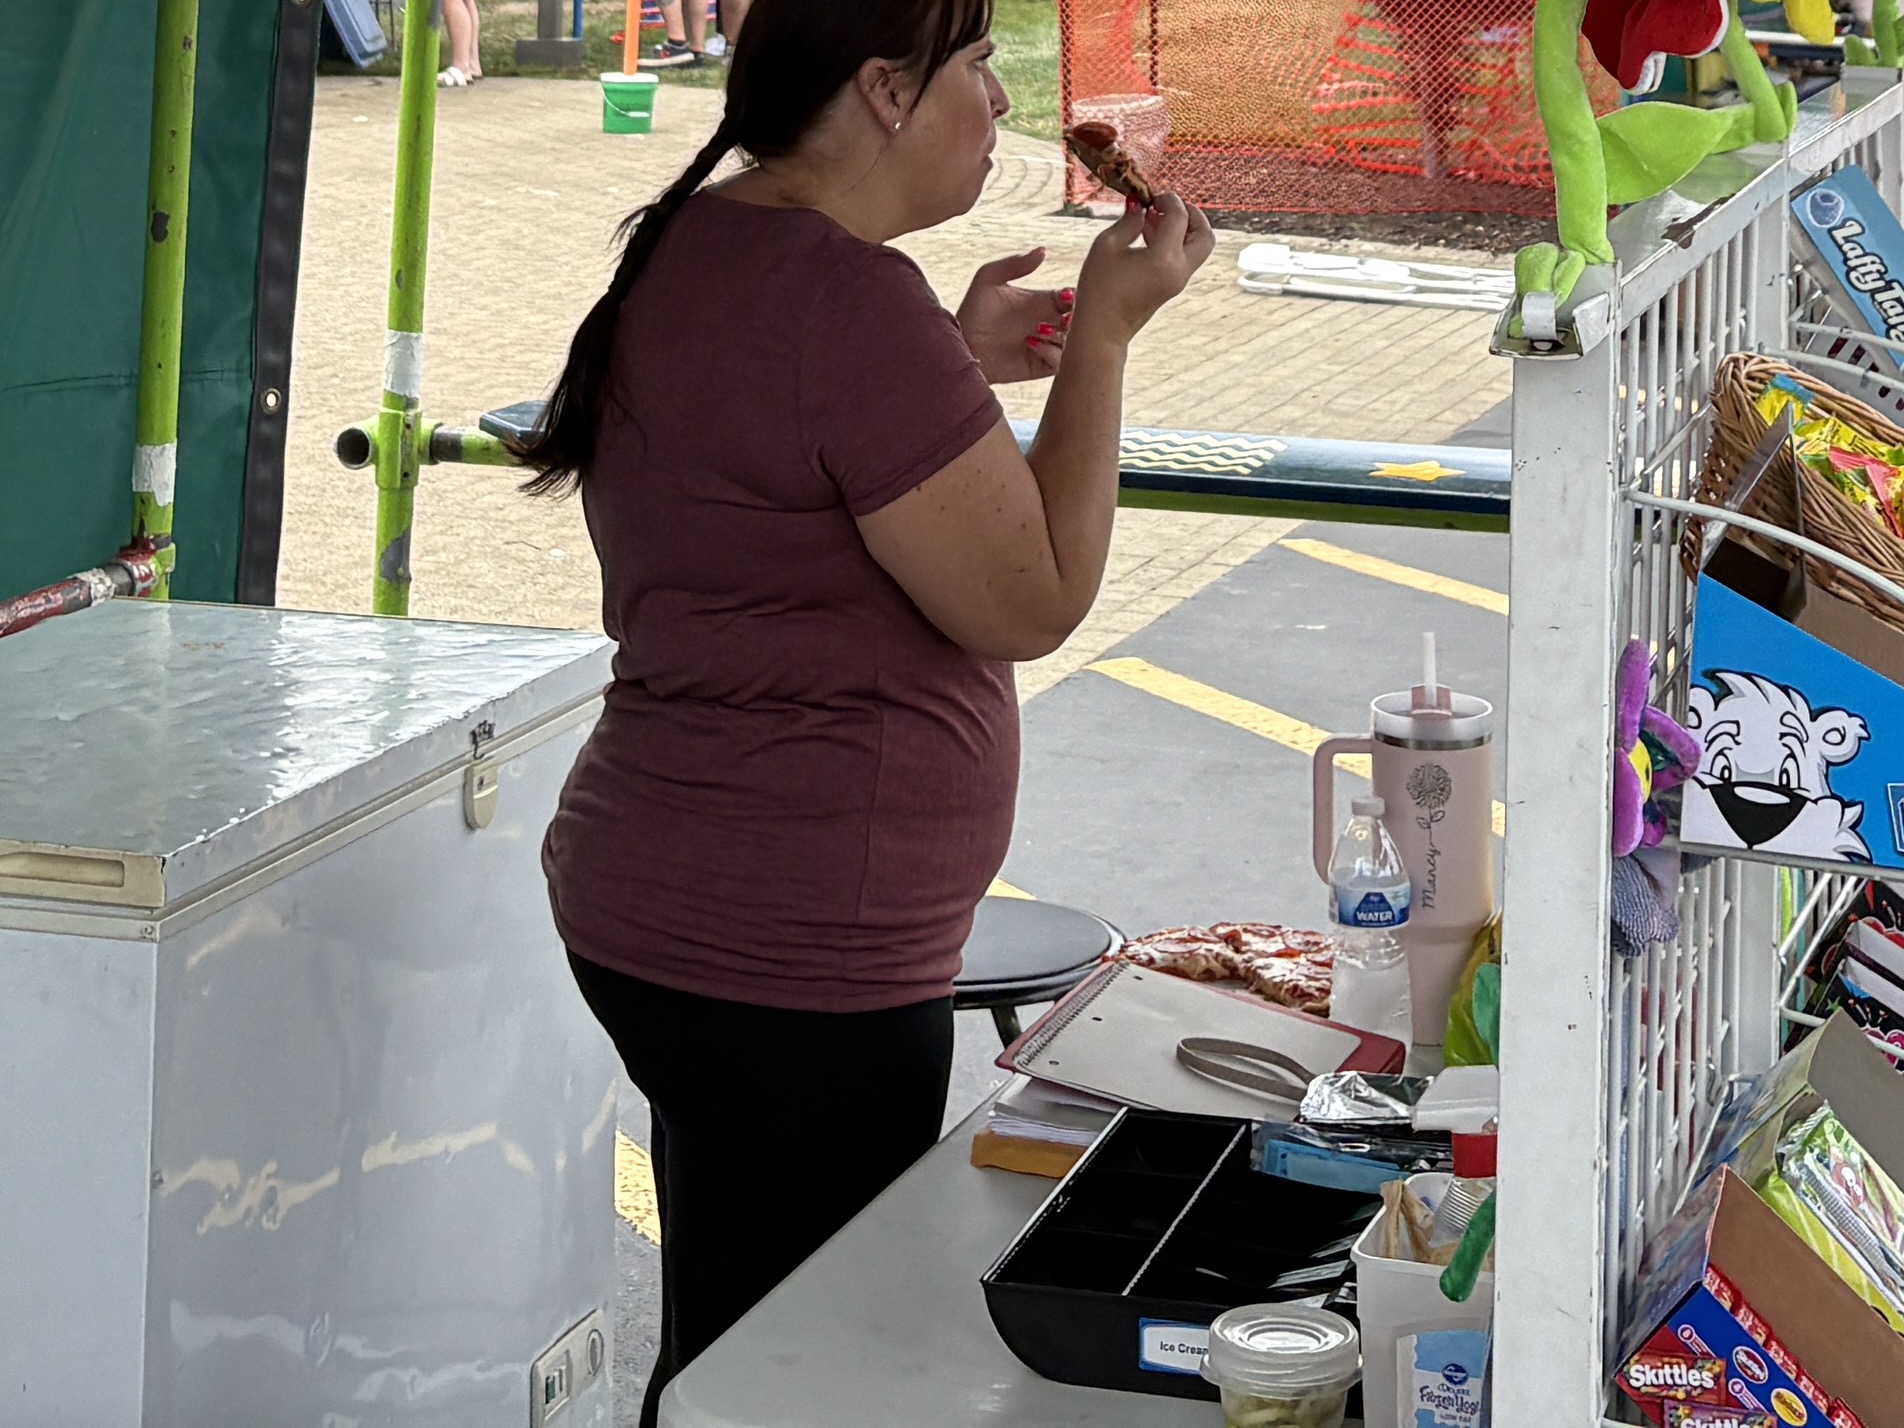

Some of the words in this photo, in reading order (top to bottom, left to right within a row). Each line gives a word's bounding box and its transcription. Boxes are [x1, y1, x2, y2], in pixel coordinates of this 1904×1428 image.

[1831, 220, 1887, 293] Laffy
[1356, 911, 1392, 921] WATER
[1629, 1363, 1715, 1389] Skittles
